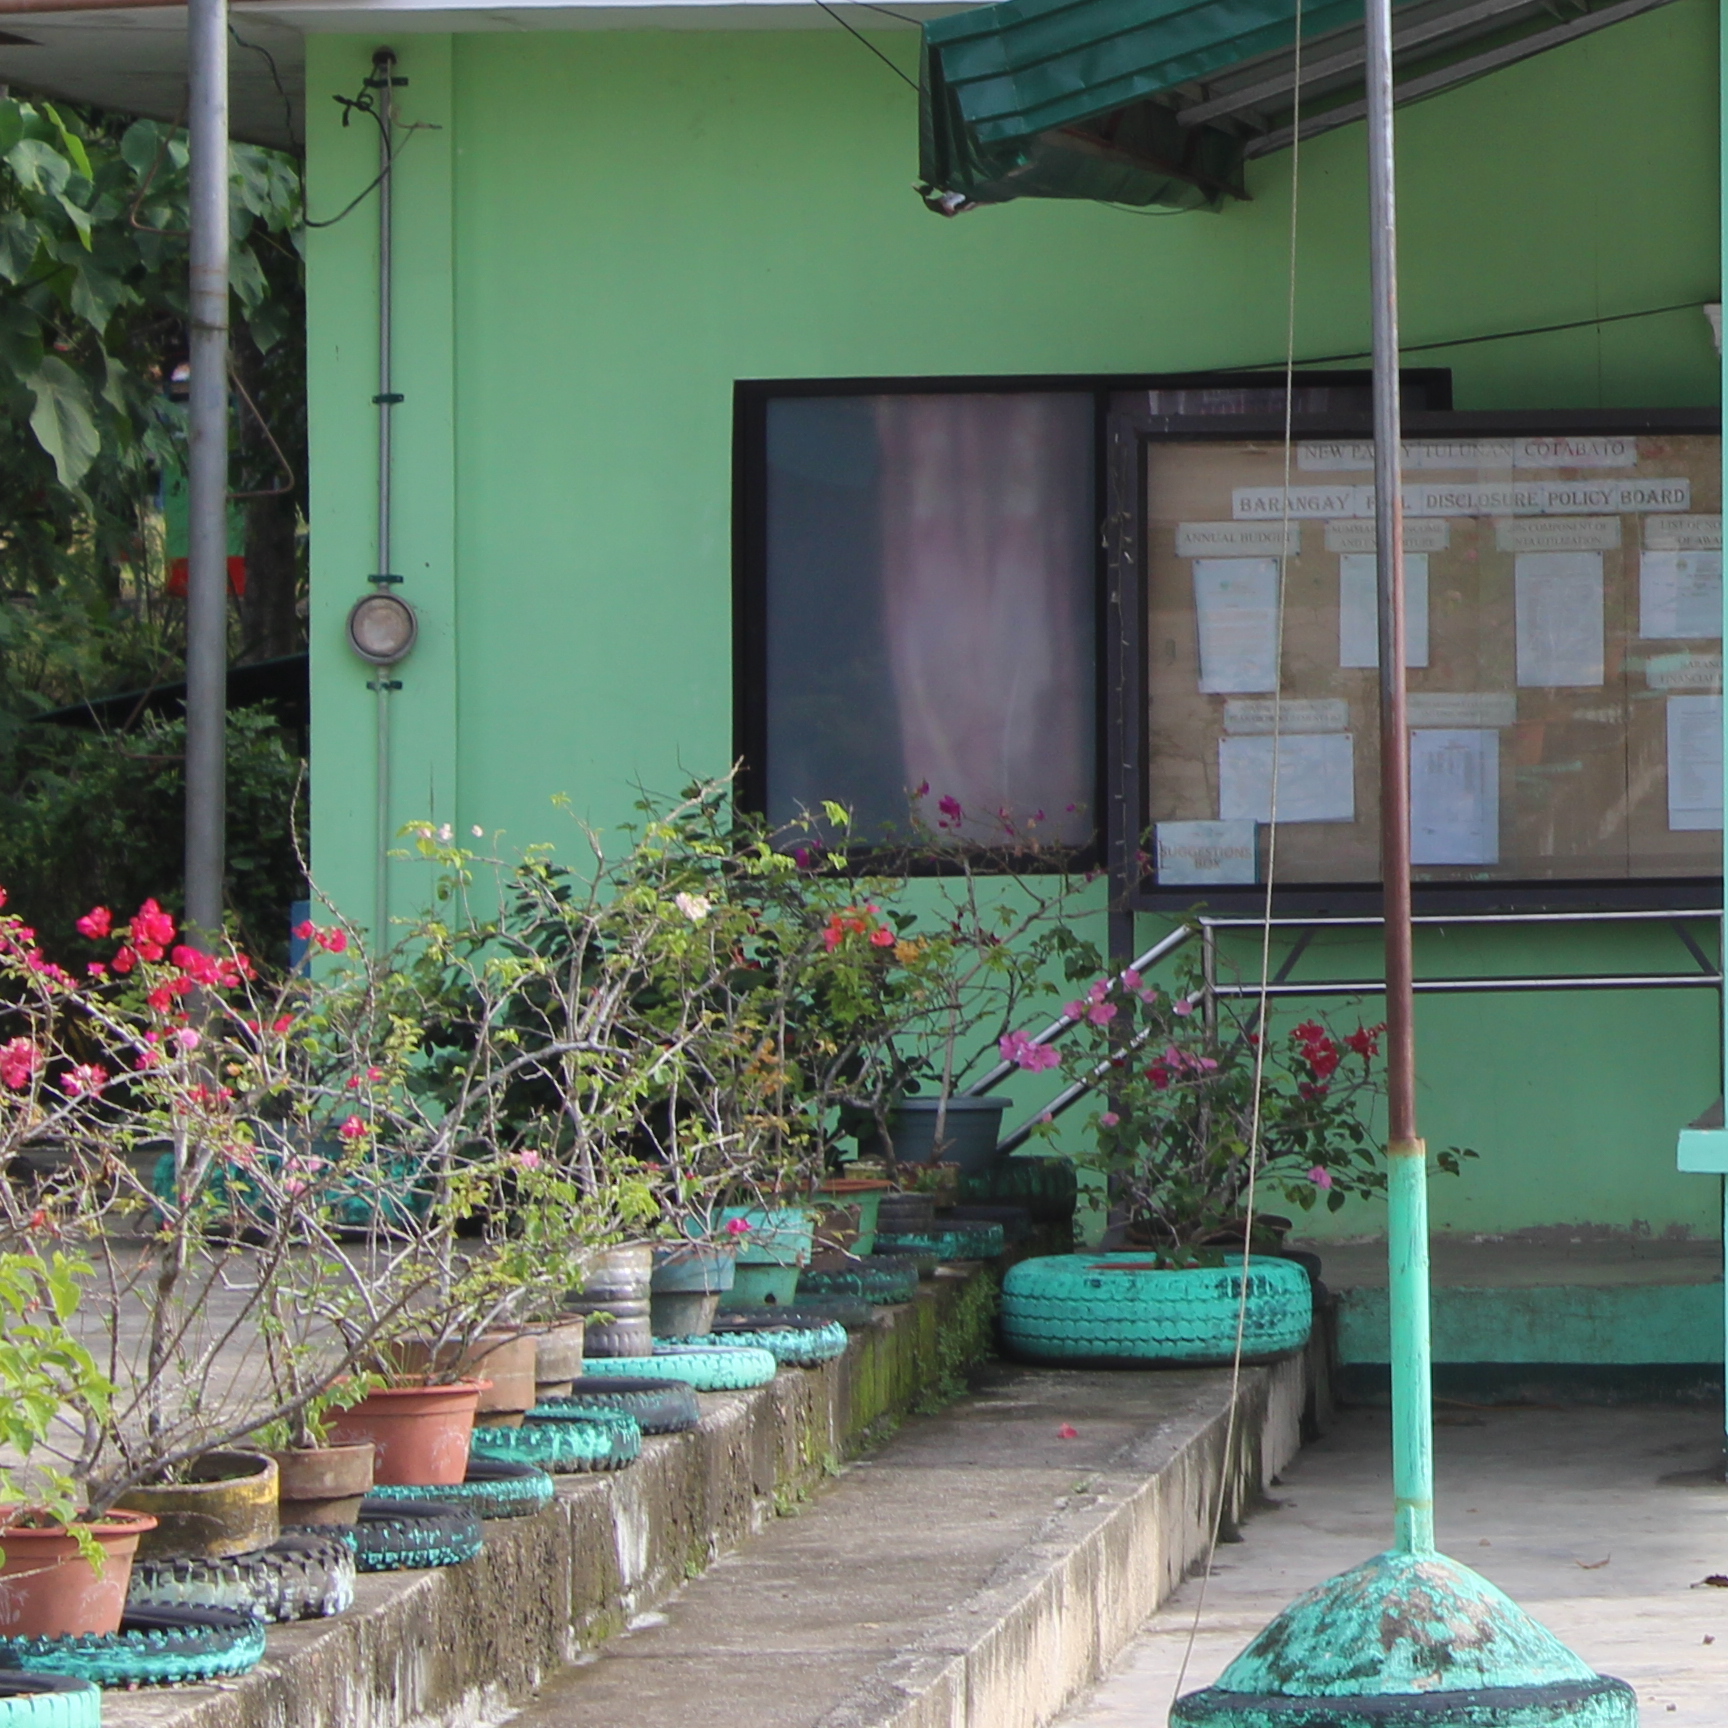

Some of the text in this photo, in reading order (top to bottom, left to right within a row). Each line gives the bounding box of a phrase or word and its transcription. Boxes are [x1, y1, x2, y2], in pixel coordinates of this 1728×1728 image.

[1305, 444, 1343, 459] NEW
[1423, 444, 1511, 459] TULUNAN
[1524, 443, 1625, 457] COTABATO
[1239, 493, 1350, 513] BARANGAY
[1426, 491, 1538, 510] DISCLOSURE
[1548, 490, 1612, 506] POLICY
[1620, 488, 1686, 505] BOARD
[1184, 532, 1236, 544] ANNUAL
[1160, 845, 1252, 859] SUGGESTIONS
